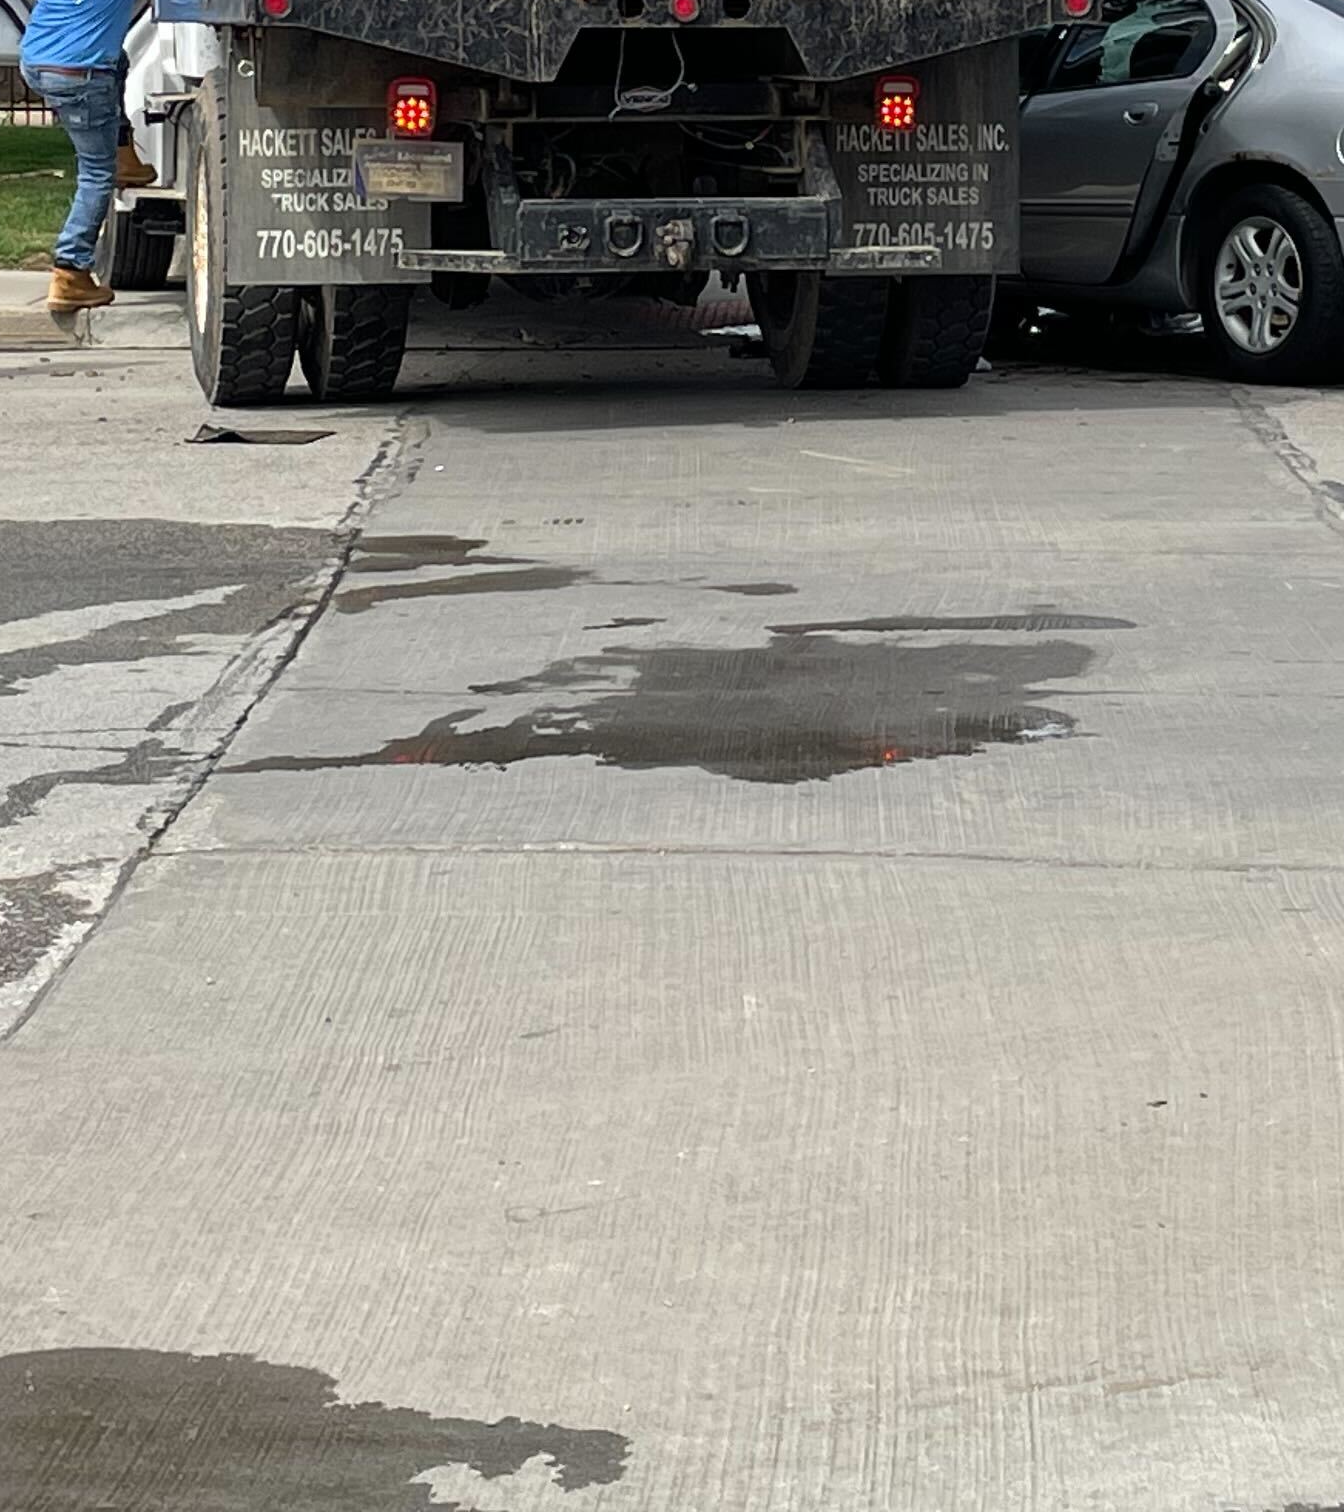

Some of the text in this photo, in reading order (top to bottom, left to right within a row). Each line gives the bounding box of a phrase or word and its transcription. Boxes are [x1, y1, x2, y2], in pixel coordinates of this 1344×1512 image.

[238, 127, 318, 157] HACKETT
[835, 124, 1009, 154] HACKETT SALES, INC.
[857, 163, 989, 182] SPECIALIZING IN
[271, 192, 389, 212] TRUCK SALES
[866, 187, 979, 206] TRUCK SALES
[256, 228, 403, 258] 770-605-1475
[852, 222, 994, 250] 770-605-1475
